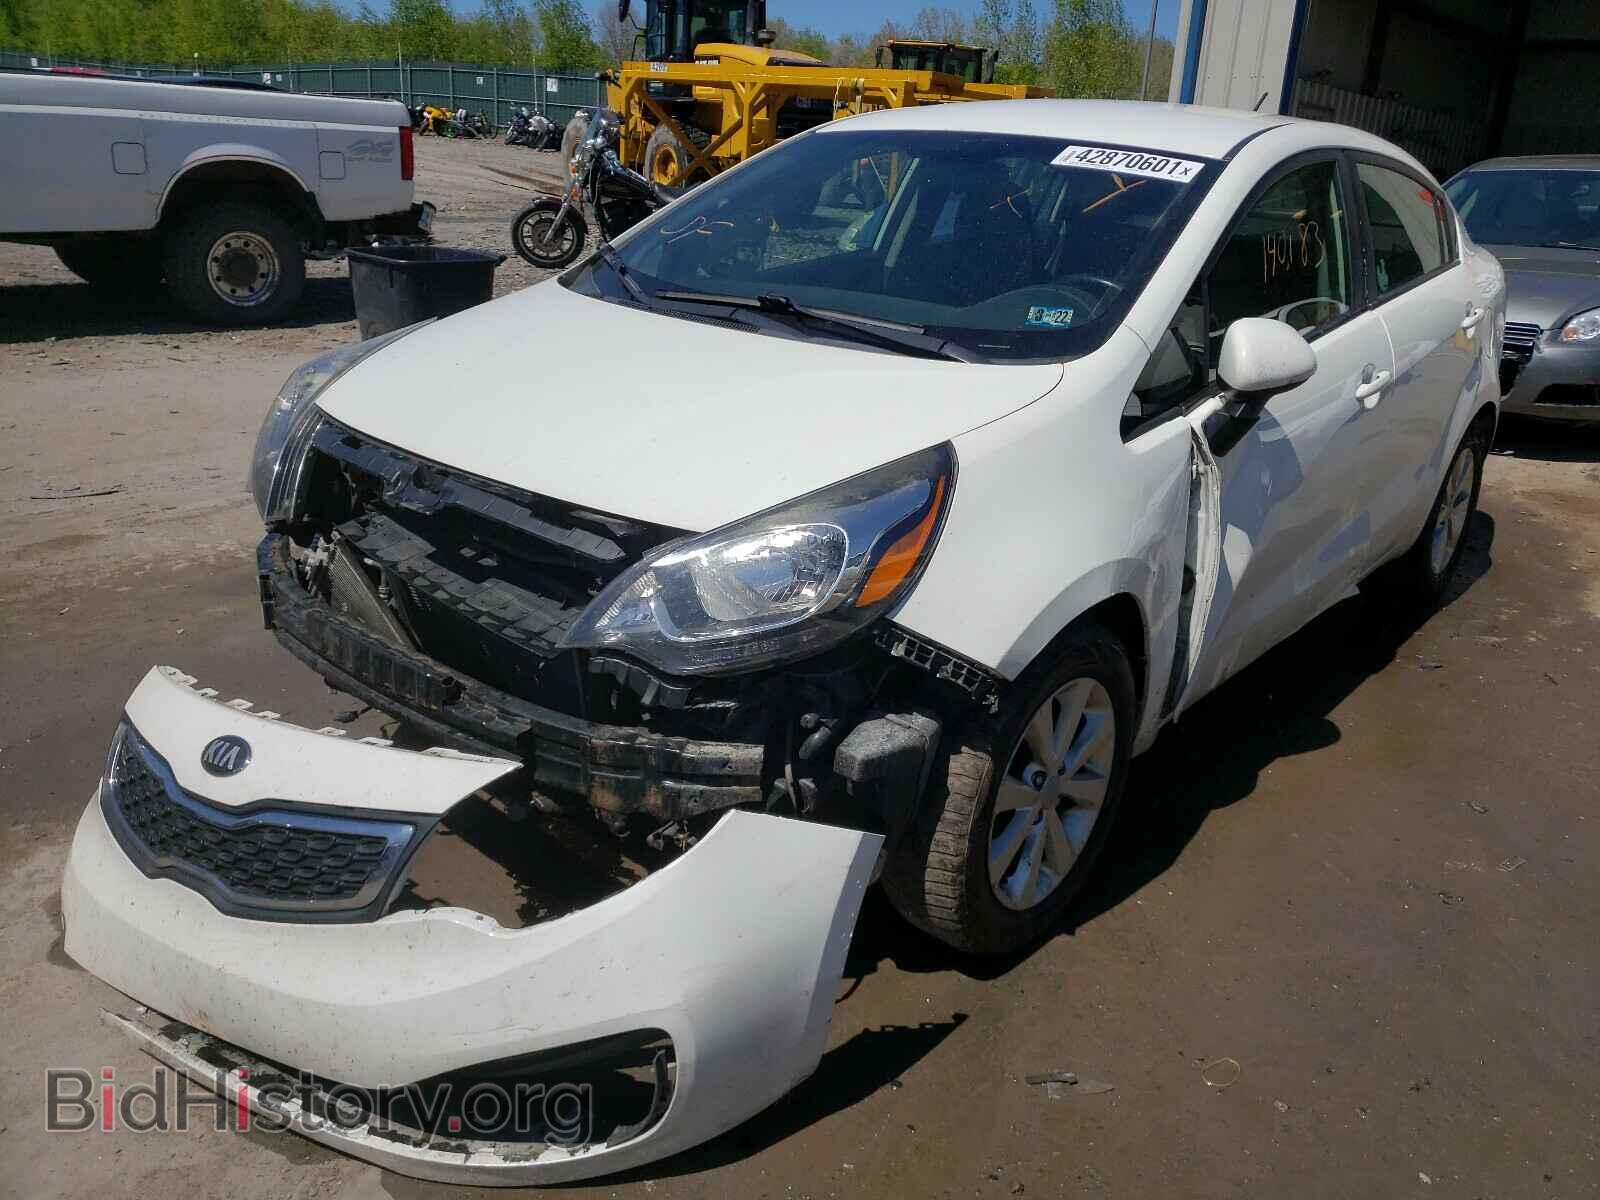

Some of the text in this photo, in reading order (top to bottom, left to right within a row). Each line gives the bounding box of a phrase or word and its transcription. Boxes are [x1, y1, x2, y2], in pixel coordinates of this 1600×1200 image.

[1075, 149, 1183, 175] 42870601
[1055, 310, 1070, 323] 22
[208, 740, 241, 770] KIA
